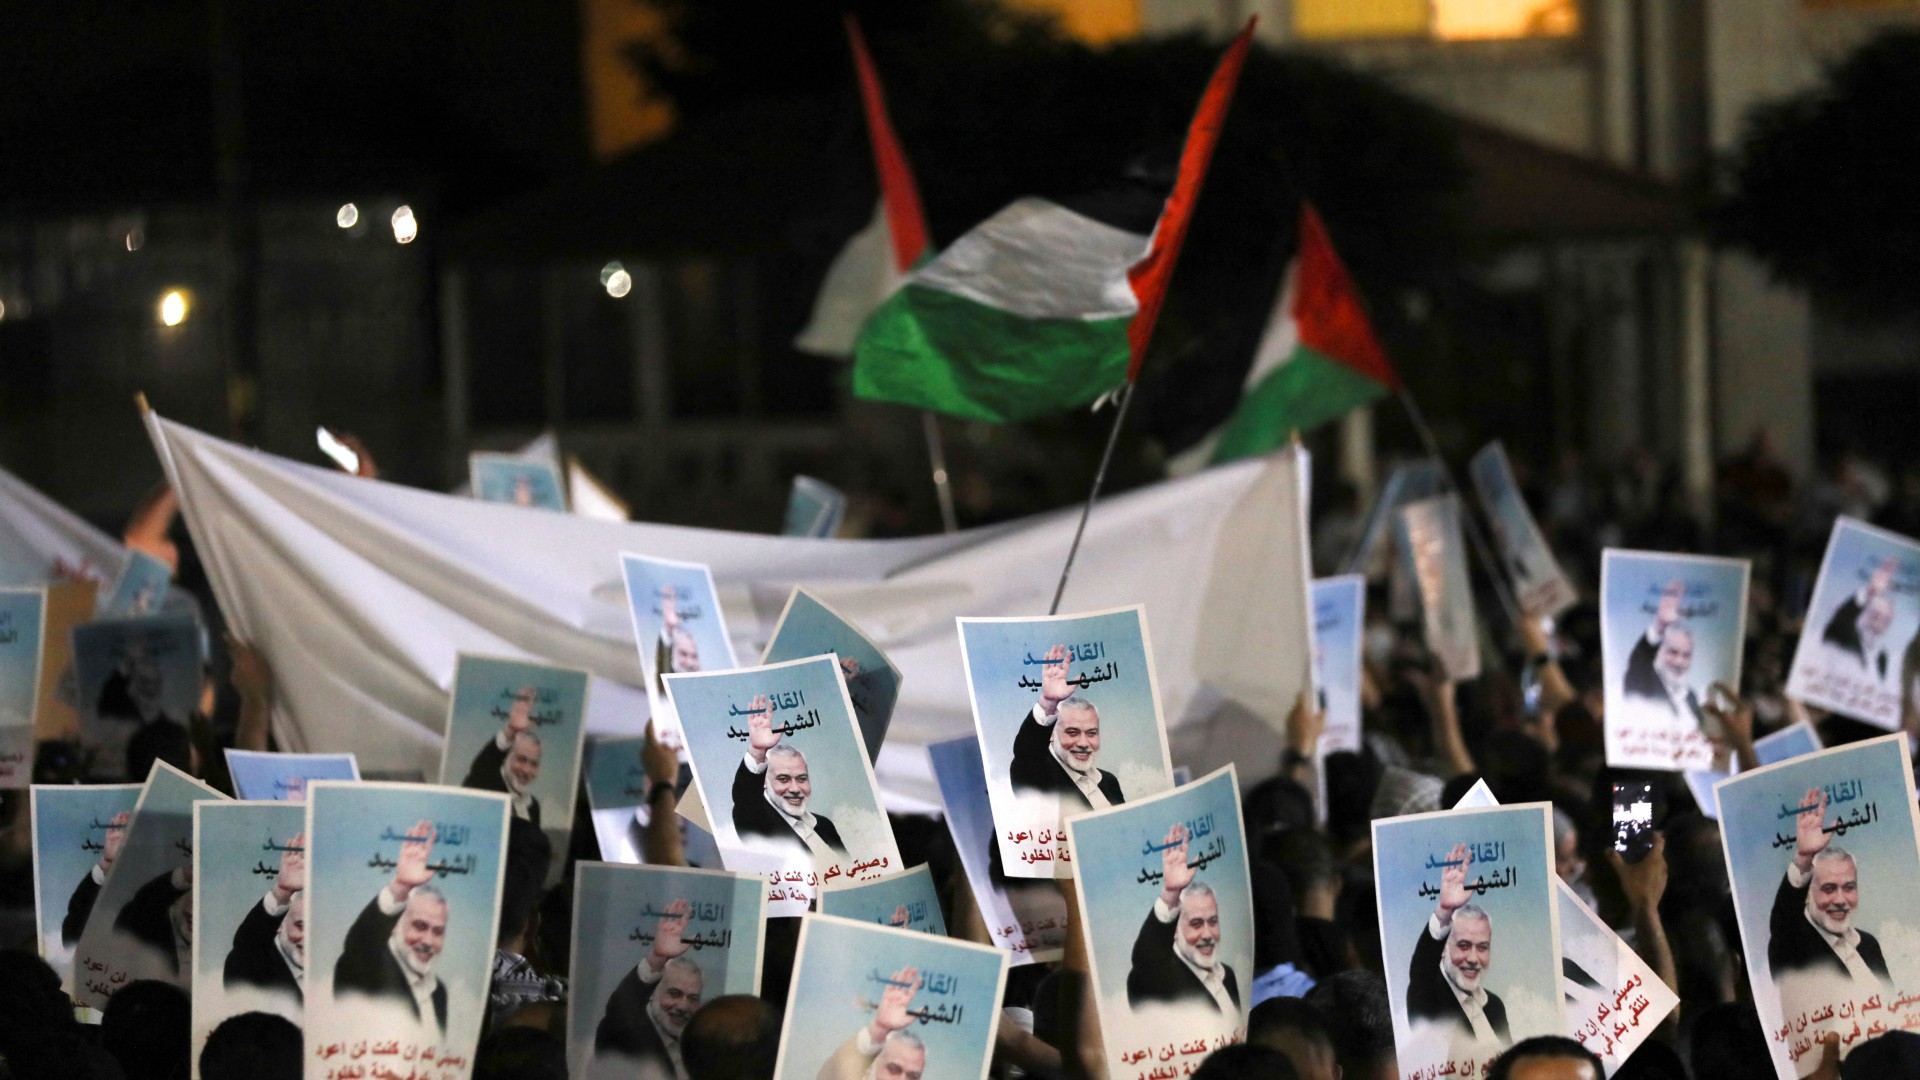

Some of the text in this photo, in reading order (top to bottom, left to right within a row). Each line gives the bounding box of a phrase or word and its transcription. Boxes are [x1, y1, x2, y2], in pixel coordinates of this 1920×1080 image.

[1022, 641, 1106, 666] القائد
[1018, 661, 1119, 693] الشهيد
[728, 689, 806, 717] القائد
[726, 708, 821, 742] الشهيد
[1776, 778, 1863, 820] القائد
[1007, 829, 1034, 844] اعود
[1038, 829, 1052, 845] لن
[1141, 811, 1215, 856] القائد
[1772, 801, 1878, 851] الشهيد
[367, 852, 477, 879] الشهيد
[1021, 846, 1071, 865] نة الخلود
[1136, 834, 1226, 886] الشهيد
[1425, 840, 1506, 870] القائد
[769, 870, 782, 886] لن
[784, 870, 804, 882] كنت
[823, 864, 842, 885] لكم
[845, 856, 889, 879] وصيتي
[1417, 866, 1517, 901] الشهيد
[640, 900, 726, 922] القائد
[628, 928, 732, 952] الشهيد
[1611, 974, 1642, 1012] وصيتي
[1811, 1004, 1834, 1023] كنت
[1861, 993, 1882, 1018] لكم
[1774, 1021, 1793, 1043] اعود
[1796, 1011, 1808, 1034] لن
[1841, 1020, 1861, 1046] في
[316, 1040, 346, 1060] اعود
[350, 1040, 367, 1060] لن
[1120, 1047, 1153, 1066] اعود
[1158, 1043, 1176, 1062] لن
[1179, 1039, 1208, 1056] كنت
[1788, 1036, 1813, 1062] الخلود
